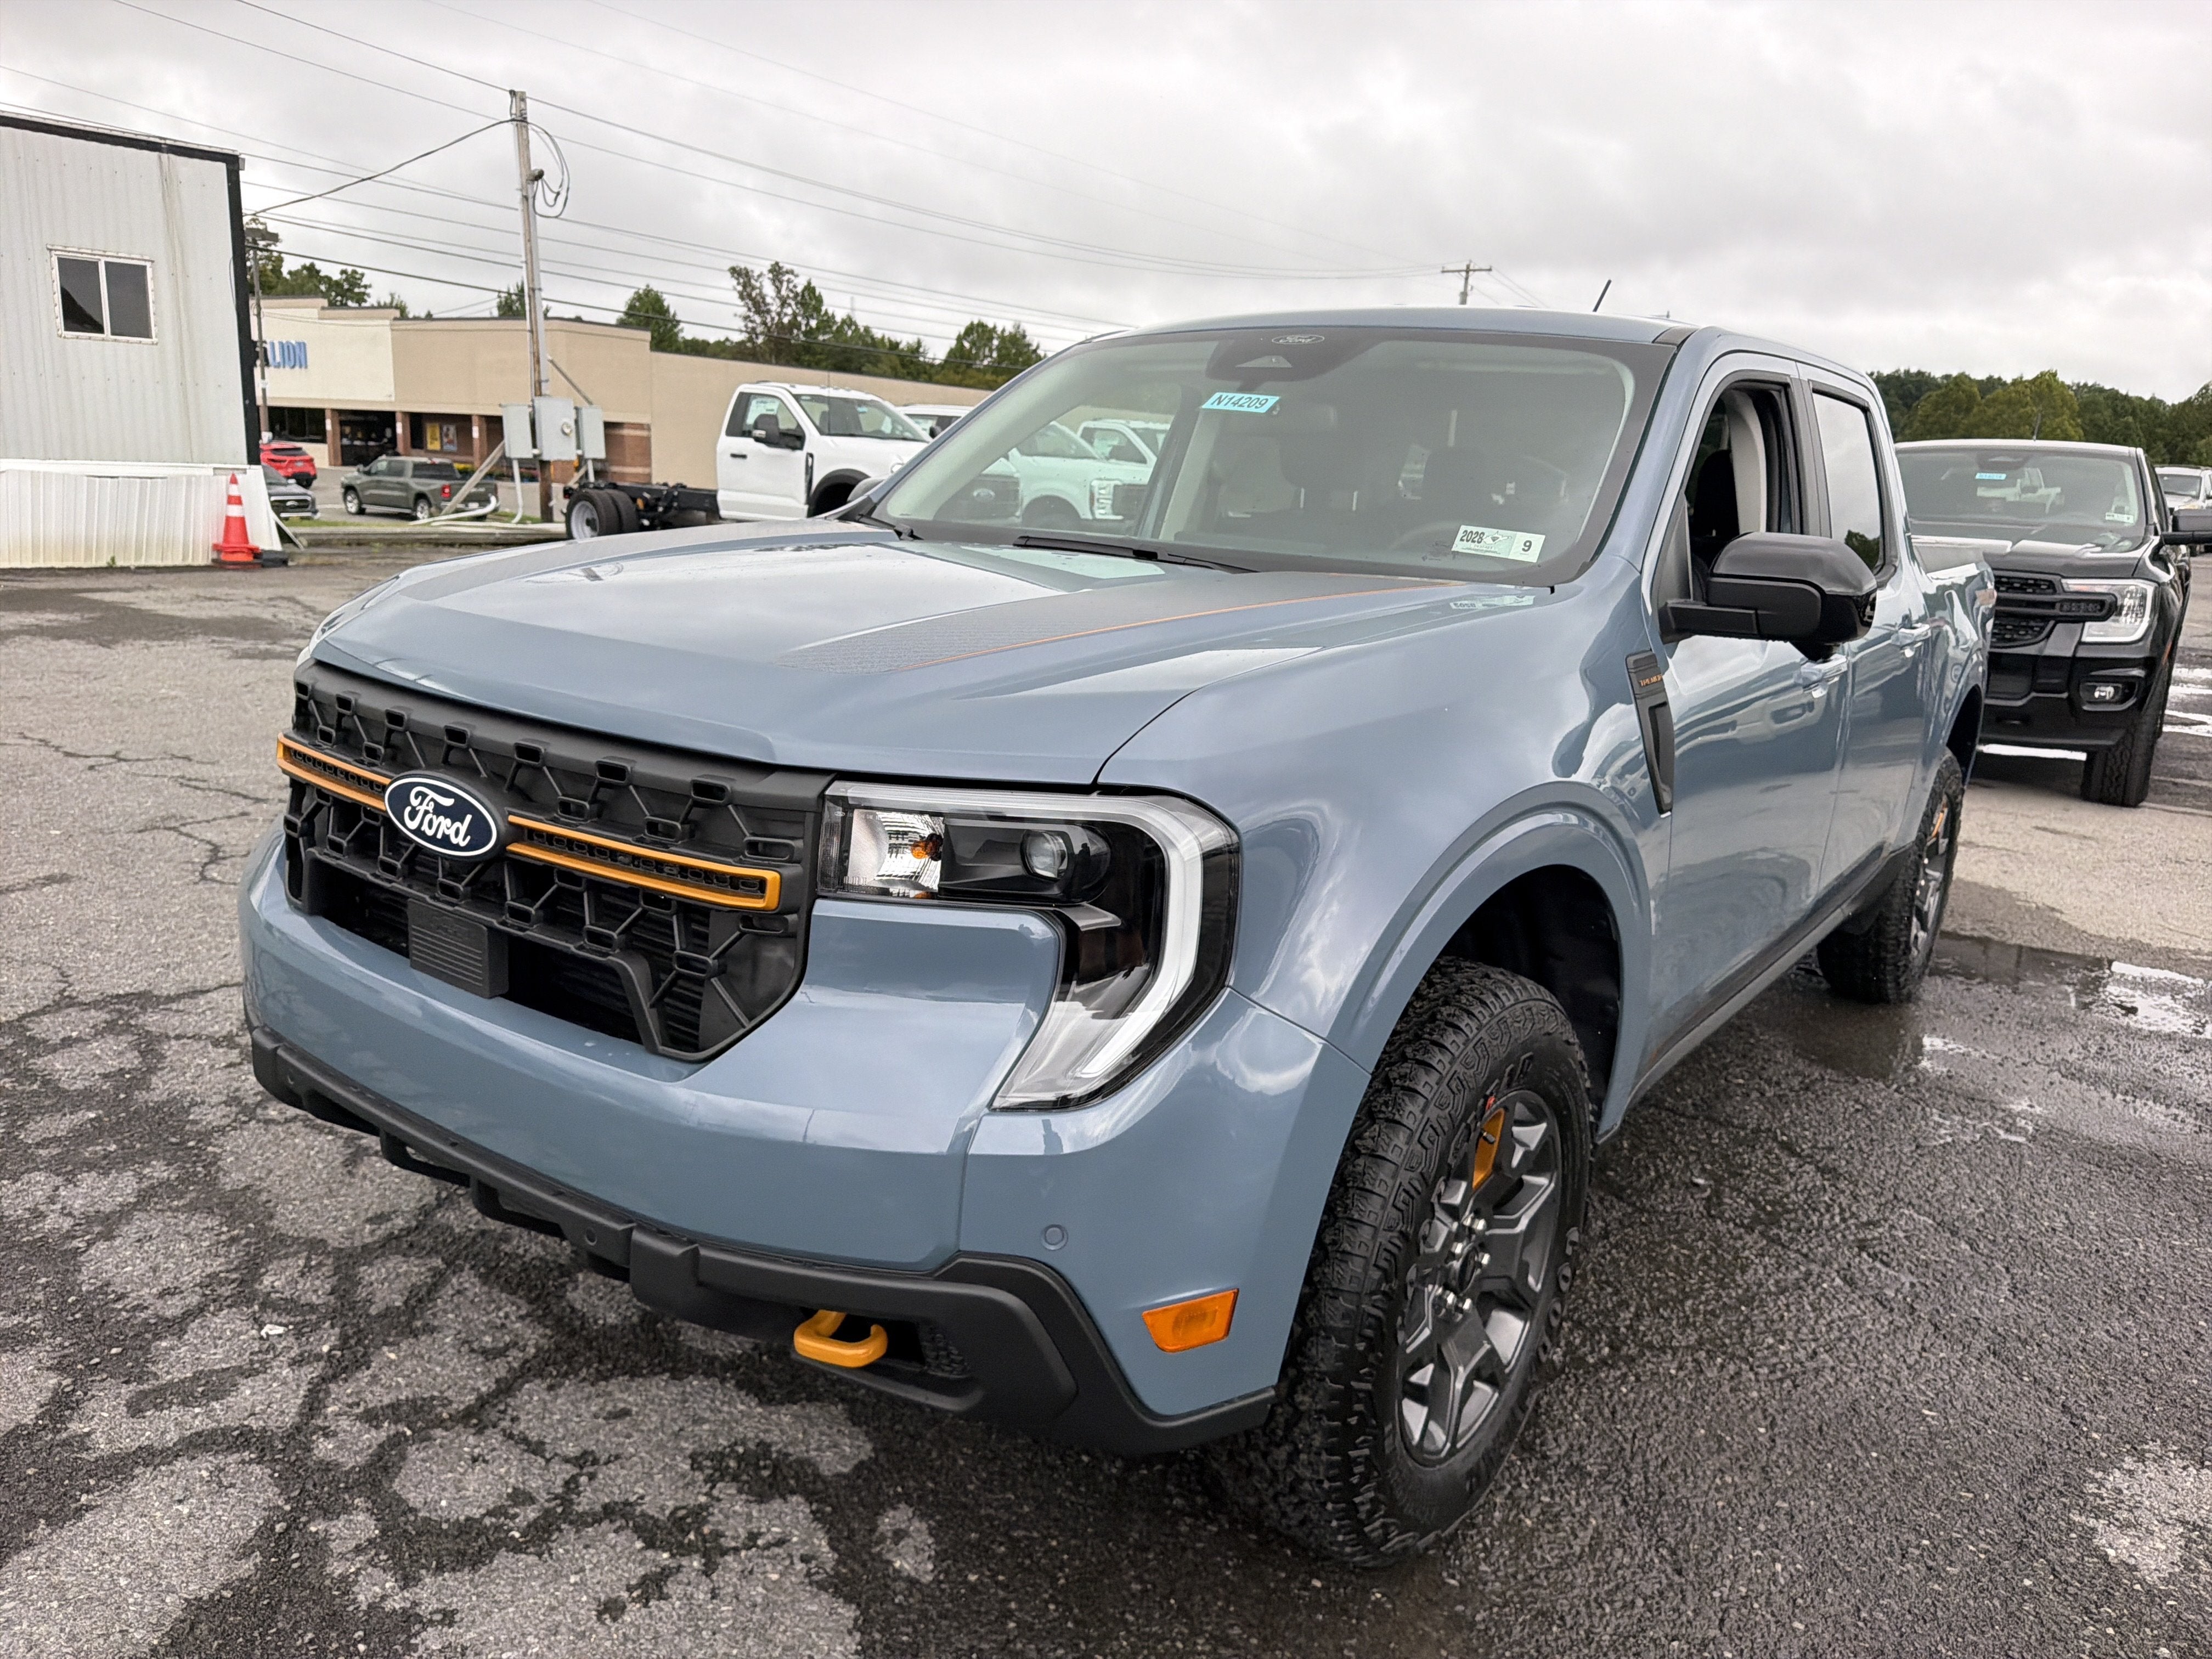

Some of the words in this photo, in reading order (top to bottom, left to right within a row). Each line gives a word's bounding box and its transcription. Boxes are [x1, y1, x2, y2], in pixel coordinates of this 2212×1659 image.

[269, 341, 308, 369] LION
[1211, 394, 1269, 409] N14209
[1460, 530, 1485, 544] 2028
[1521, 540, 1532, 552] 9
[404, 786, 472, 847] Ford
